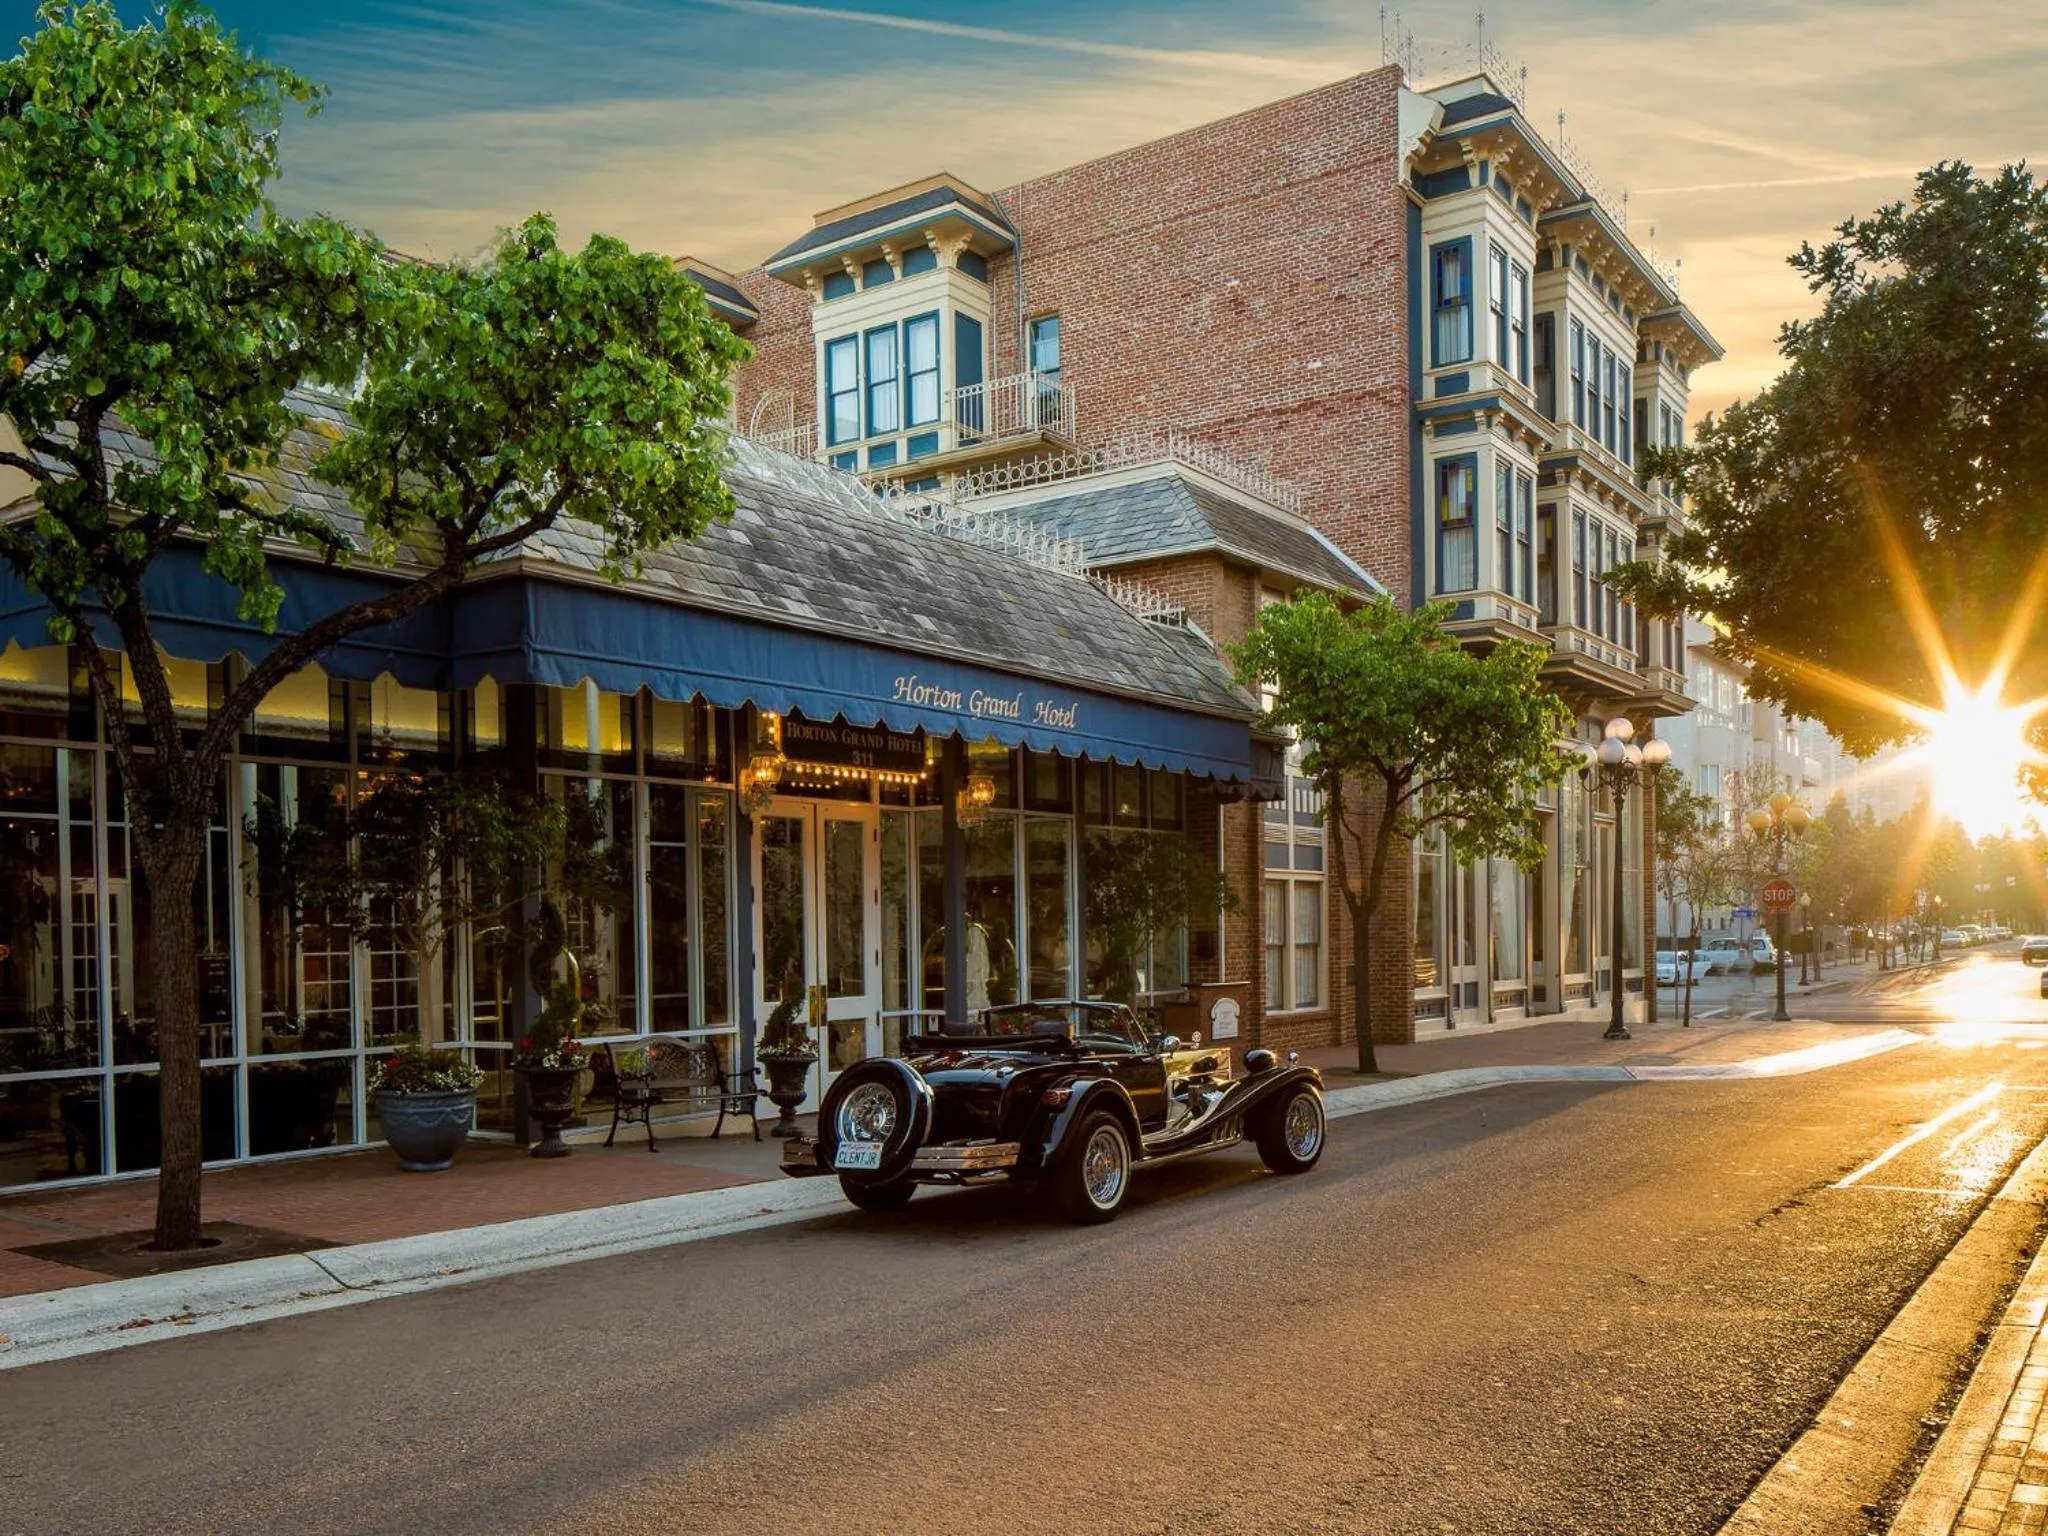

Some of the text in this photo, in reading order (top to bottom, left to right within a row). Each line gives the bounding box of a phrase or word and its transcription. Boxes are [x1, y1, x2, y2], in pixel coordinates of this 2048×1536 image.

[893, 675, 1078, 728] Horton Grand Hotel
[787, 721, 924, 754] HORTON GRAND HOTEL
[852, 750, 874, 766] 311
[1764, 889, 1794, 901] STOP
